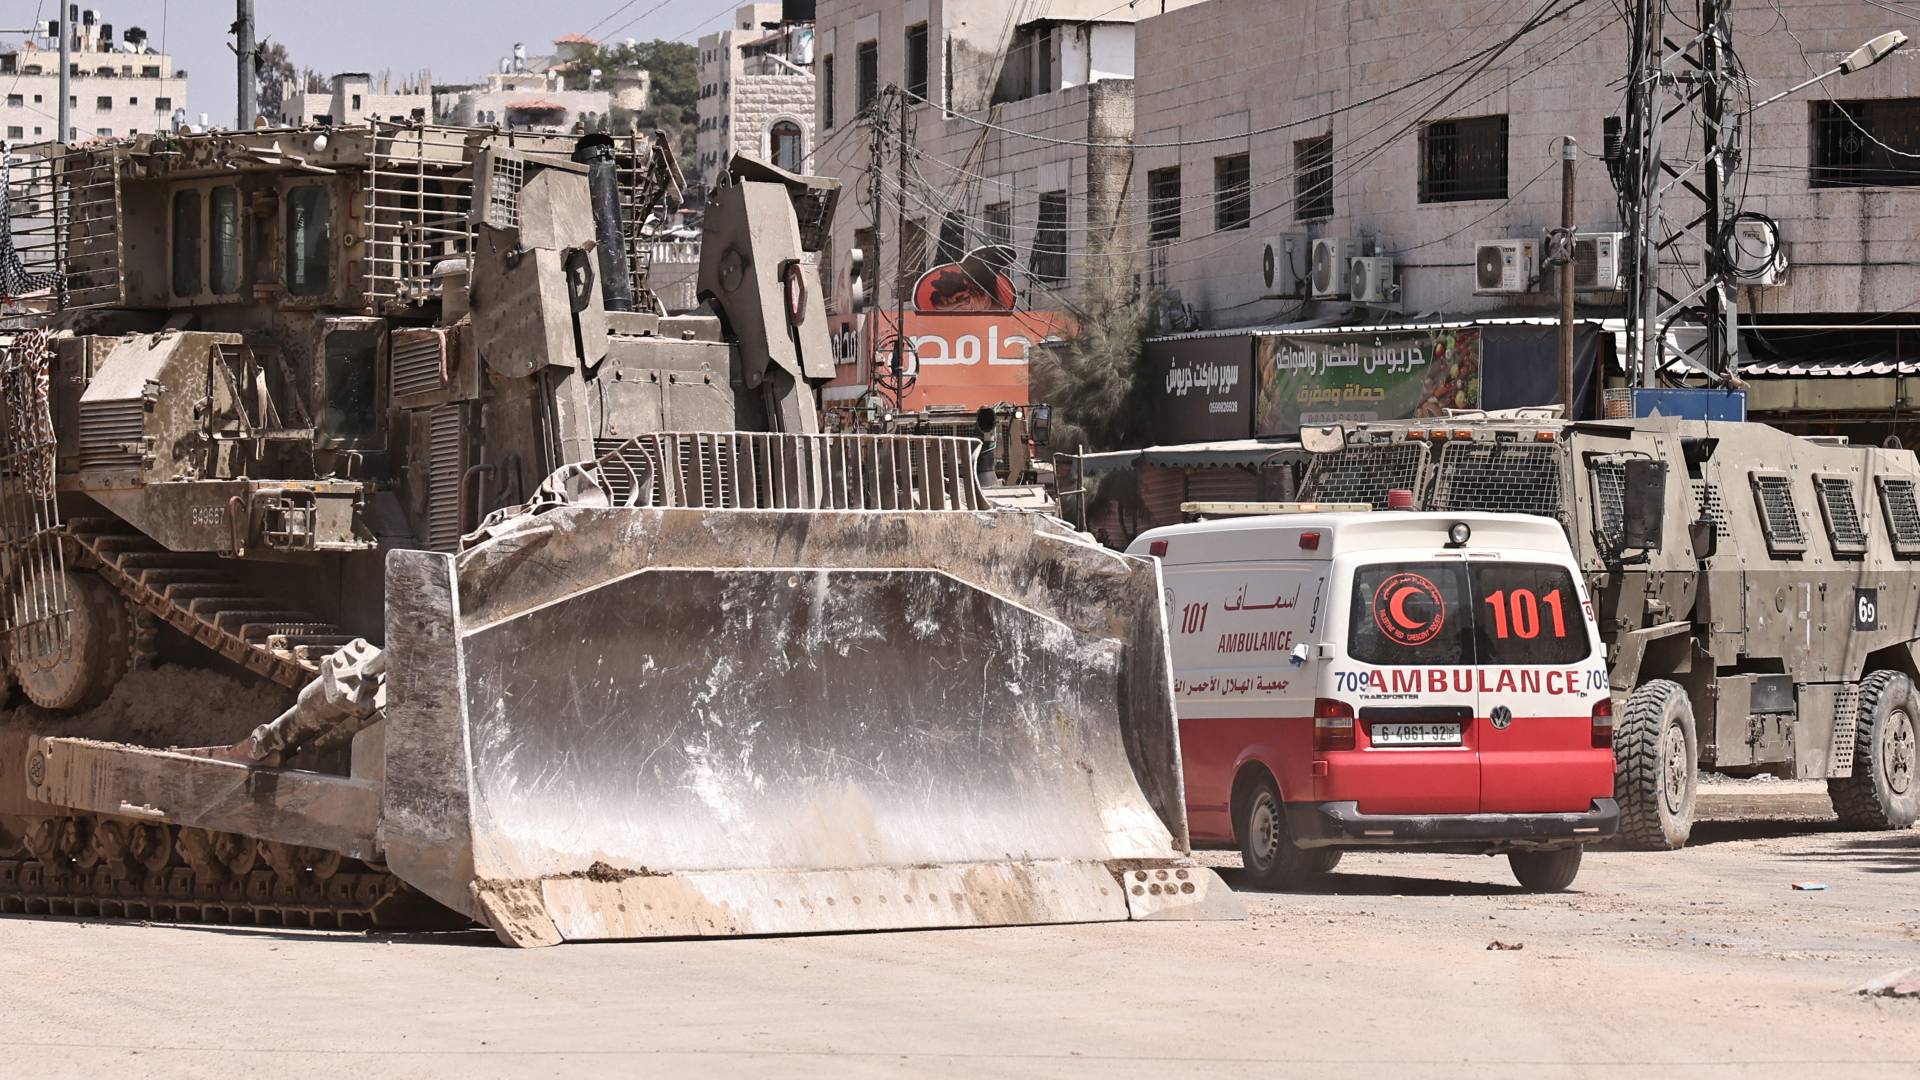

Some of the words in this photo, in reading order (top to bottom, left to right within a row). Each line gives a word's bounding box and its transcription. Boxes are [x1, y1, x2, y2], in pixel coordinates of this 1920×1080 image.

[1319, 342, 1359, 376] للخضار
[1363, 336, 1426, 375] خريوش
[1165, 355, 1193, 397] خريوش
[1193, 361, 1219, 395] ماركت
[1218, 364, 1239, 395] سوبر
[1181, 602, 1209, 635] 101
[1309, 576, 1325, 634] 709
[1485, 588, 1566, 639] 101
[1217, 631, 1293, 654] AMBULANCE
[1187, 675, 1220, 696] الأحمر
[1222, 677, 1254, 696] الهلال
[1256, 676, 1289, 695] جمعية
[1334, 671, 1369, 692] 709
[1369, 669, 1581, 695] AMBULANCE
[1586, 669, 1609, 690] 709
